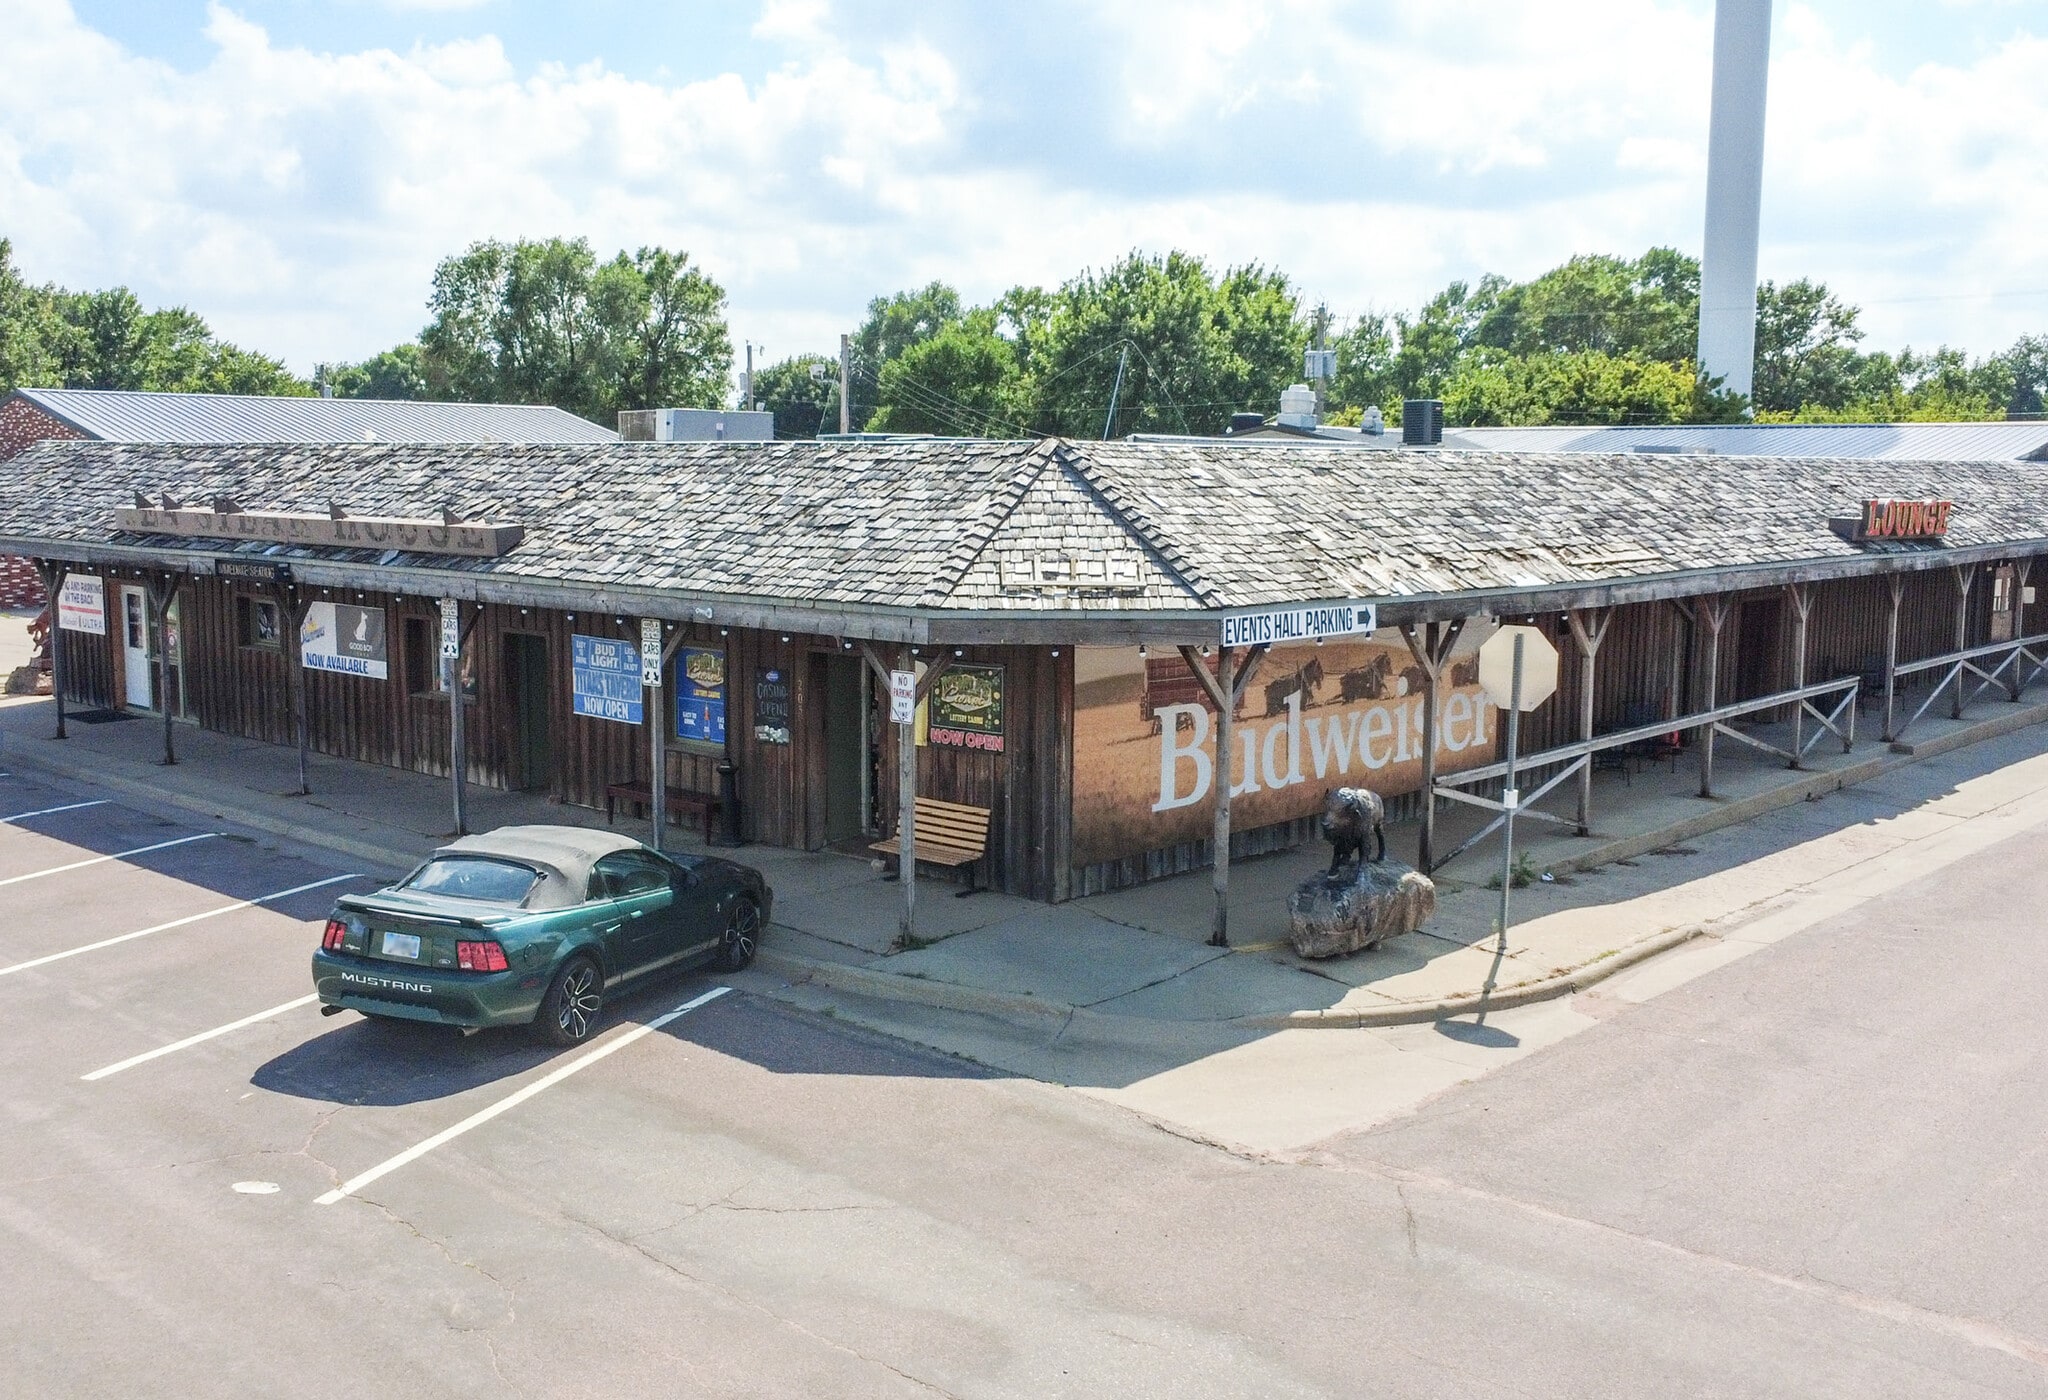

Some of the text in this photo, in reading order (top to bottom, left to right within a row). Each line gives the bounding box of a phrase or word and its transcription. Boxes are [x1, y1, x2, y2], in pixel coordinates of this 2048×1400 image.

[1866, 499, 1951, 537] LOUNGE
[1225, 606, 1353, 645] EVENTS HALL PARKING
[594, 643, 616, 657] BUD
[643, 642, 659, 655] CARS
[306, 652, 369, 675] NOW AVAILABLE
[590, 654, 619, 669] LIGHT
[643, 657, 659, 669] ONLY
[897, 675, 908, 687] NO
[893, 687, 912, 699] PARKING
[584, 696, 629, 719] NOW OPEN
[930, 727, 1004, 752] NOW OPEN
[1152, 676, 1493, 812] Budweiser
[341, 972, 433, 993] MUSTANG
